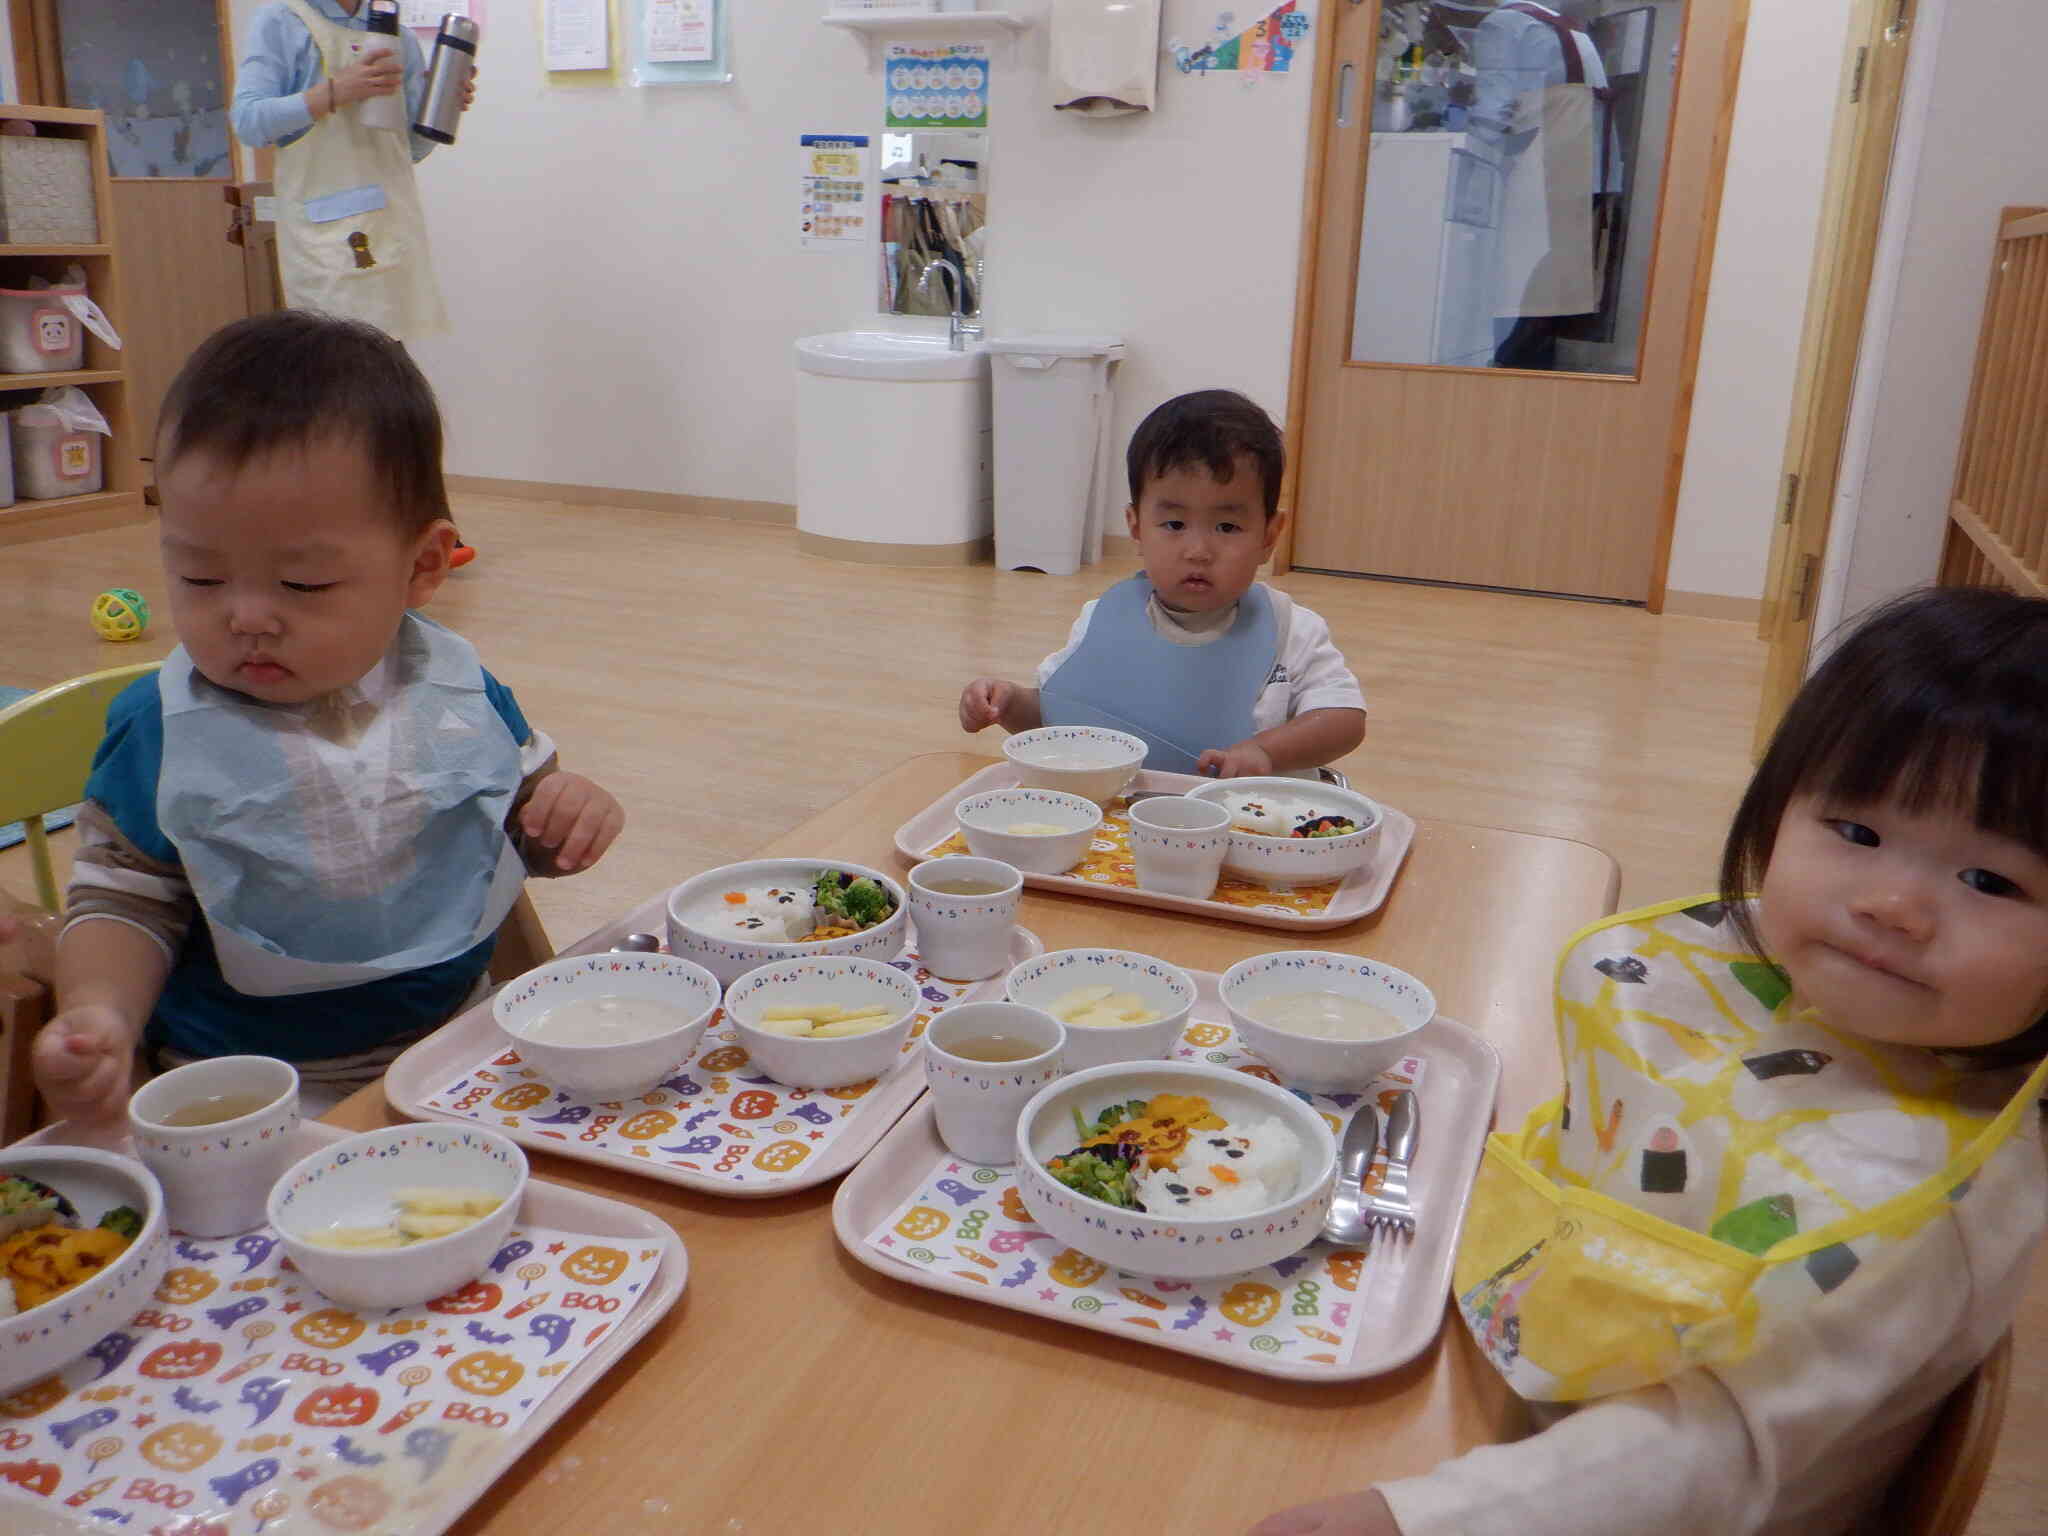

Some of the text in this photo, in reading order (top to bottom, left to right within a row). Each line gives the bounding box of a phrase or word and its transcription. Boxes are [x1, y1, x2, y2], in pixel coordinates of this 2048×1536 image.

[452, 1087, 492, 1110] BOO
[579, 1115, 618, 1142] BOO
[713, 1145, 750, 1173] BOO
[956, 1209, 990, 1241] BOO
[560, 1291, 621, 1314] BOO
[1291, 1280, 1321, 1316] BOO
[130, 1309, 193, 1333] BOO
[280, 1353, 345, 1377] BOO
[441, 1402, 509, 1428] BOO
[122, 1477, 195, 1509] BOO
